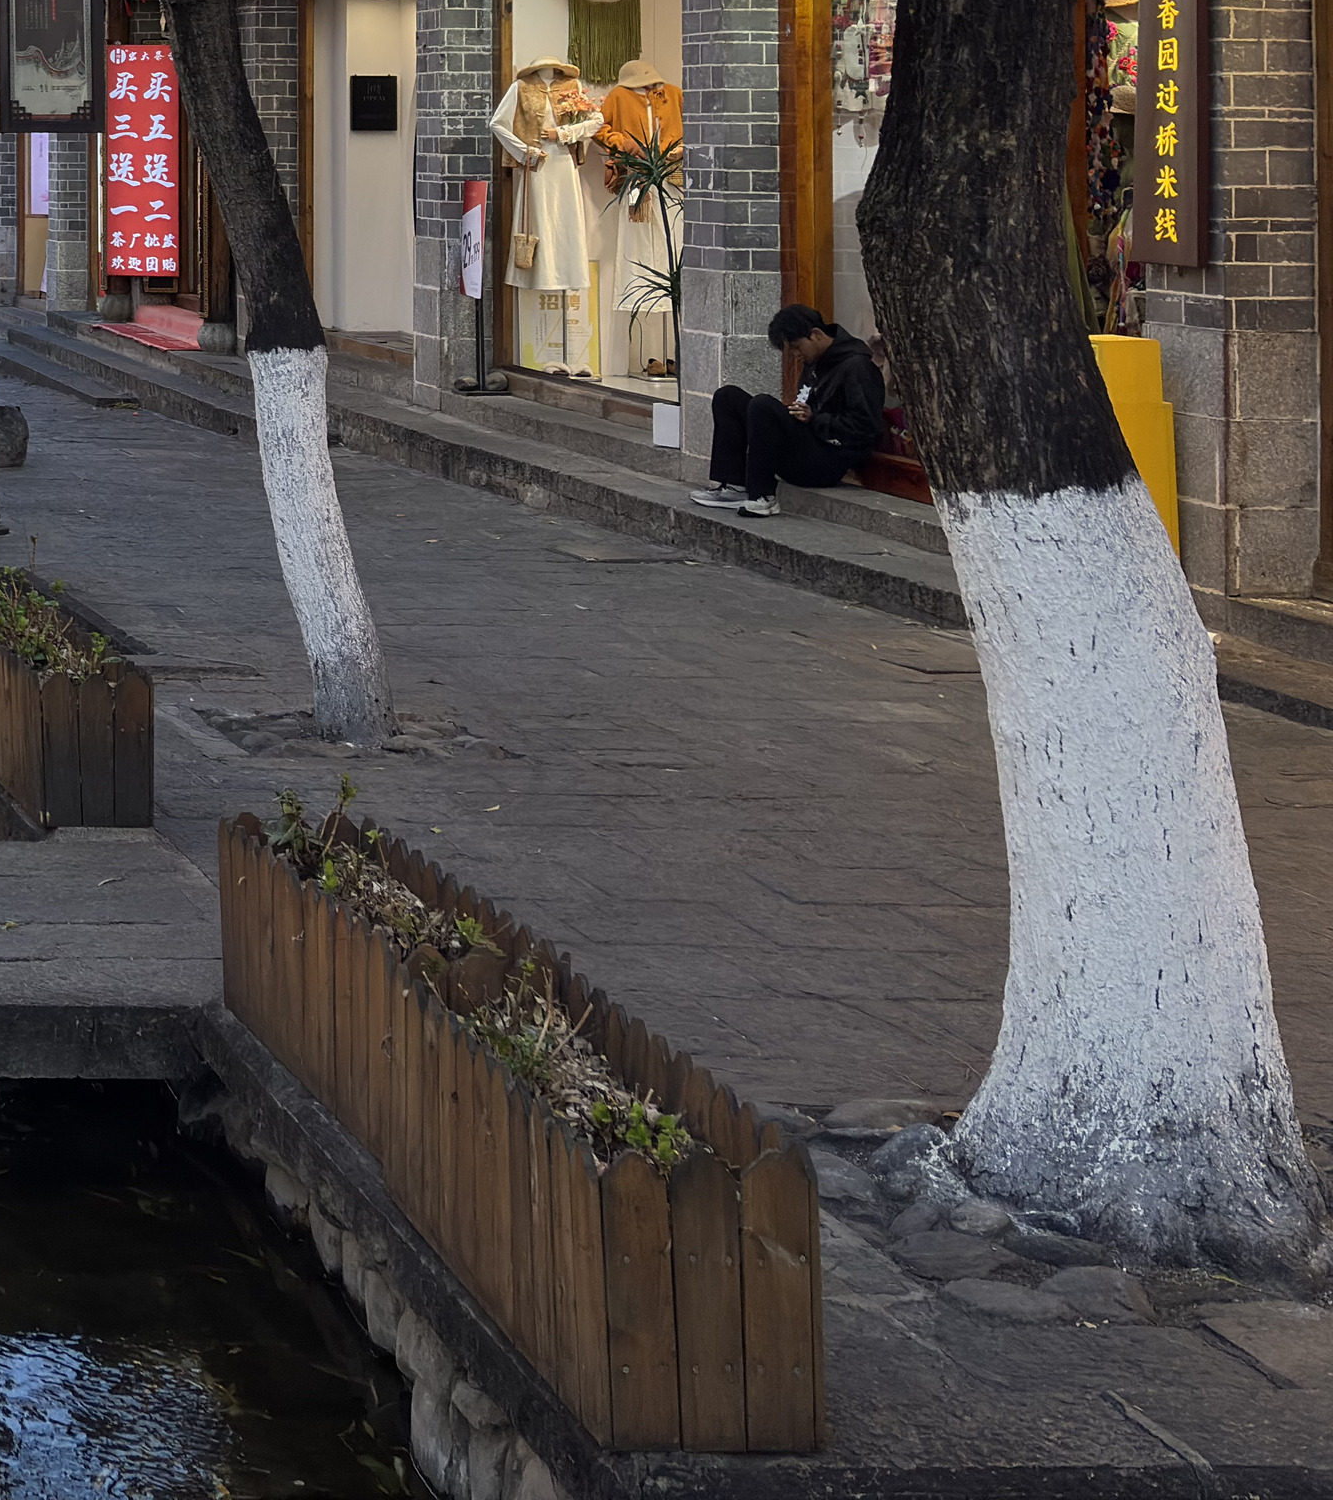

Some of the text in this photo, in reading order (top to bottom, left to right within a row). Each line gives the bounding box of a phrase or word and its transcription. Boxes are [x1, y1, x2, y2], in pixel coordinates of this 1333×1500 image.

[108, 71, 141, 216] 买三送一
[142, 71, 176, 222] 买五送二
[110, 231, 177, 249] 茶厂批发
[111, 256, 177, 273] 欢迎团购
[538, 293, 581, 311] 招聘
